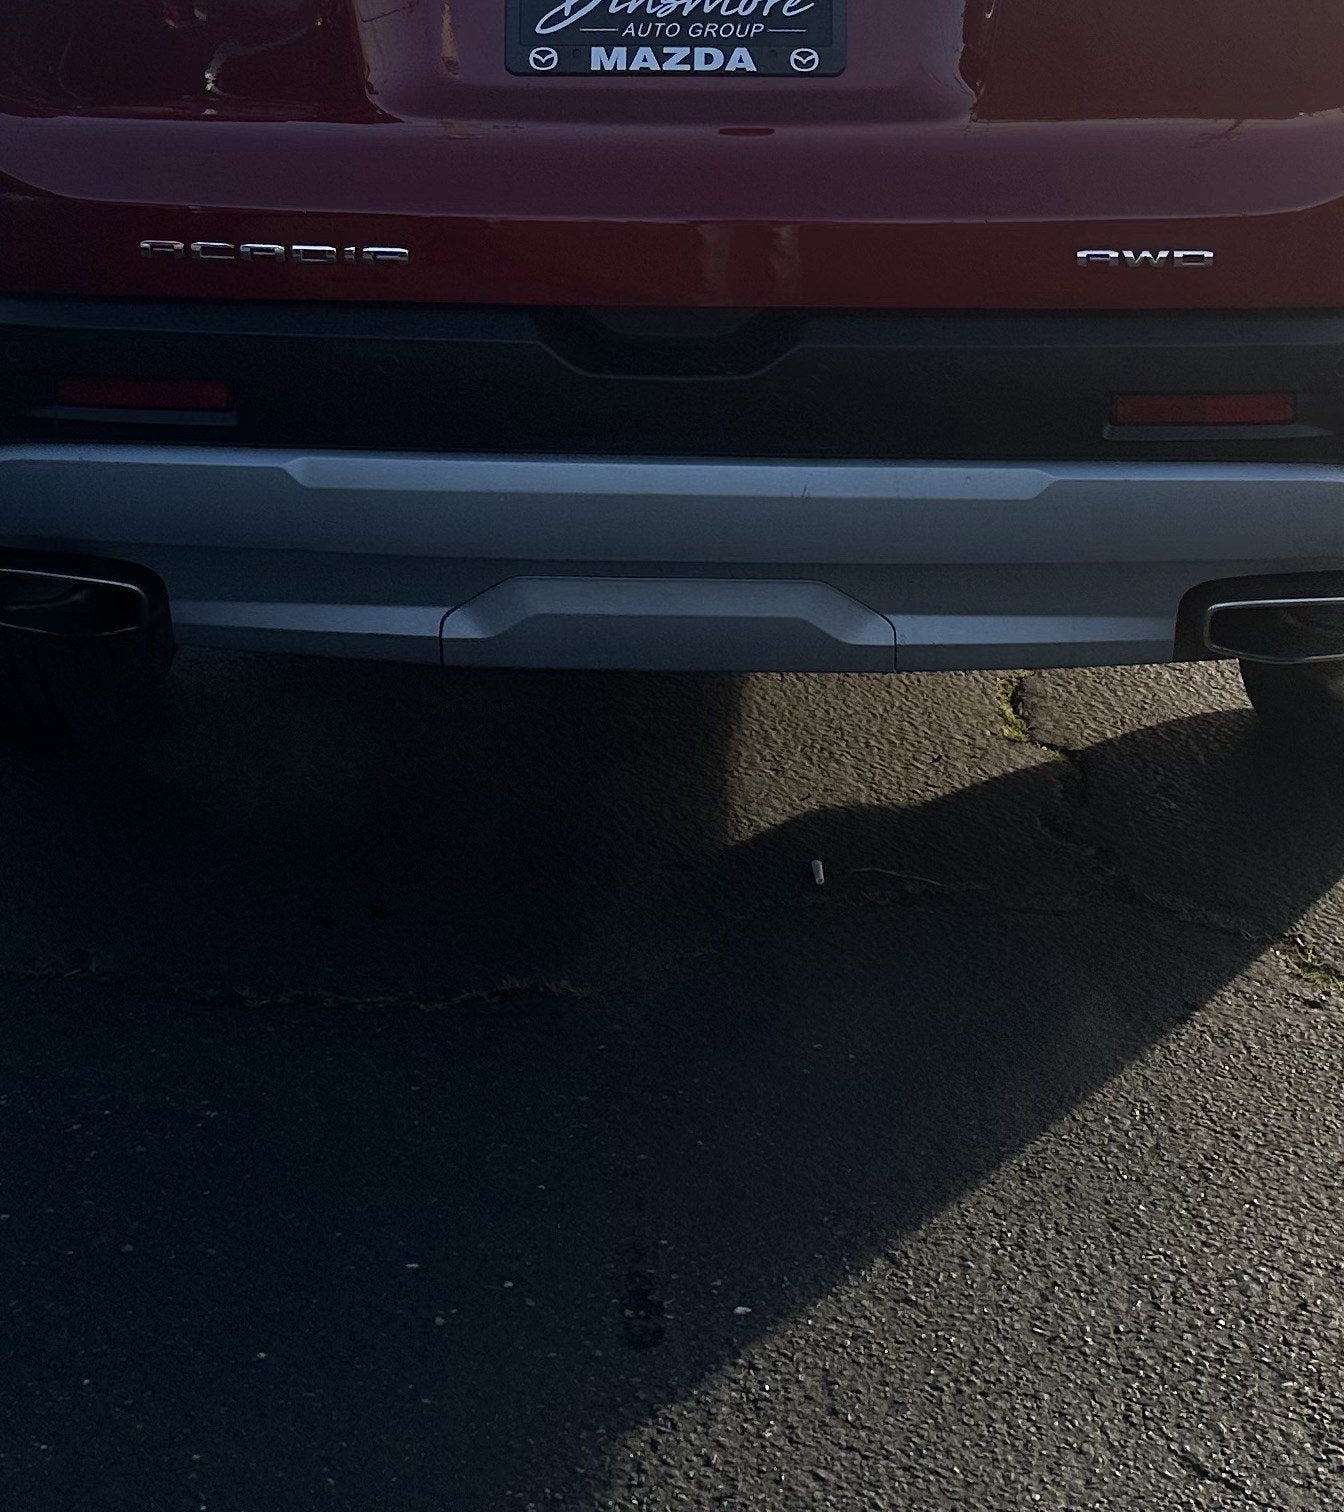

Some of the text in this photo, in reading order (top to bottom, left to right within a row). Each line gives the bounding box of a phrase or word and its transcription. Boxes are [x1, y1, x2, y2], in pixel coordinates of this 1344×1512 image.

[622, 22, 765, 38] AUTO GROUP
[590, 46, 757, 72] MAZDA
[140, 239, 409, 265] ACADIA
[1076, 249, 1214, 267] AWD
